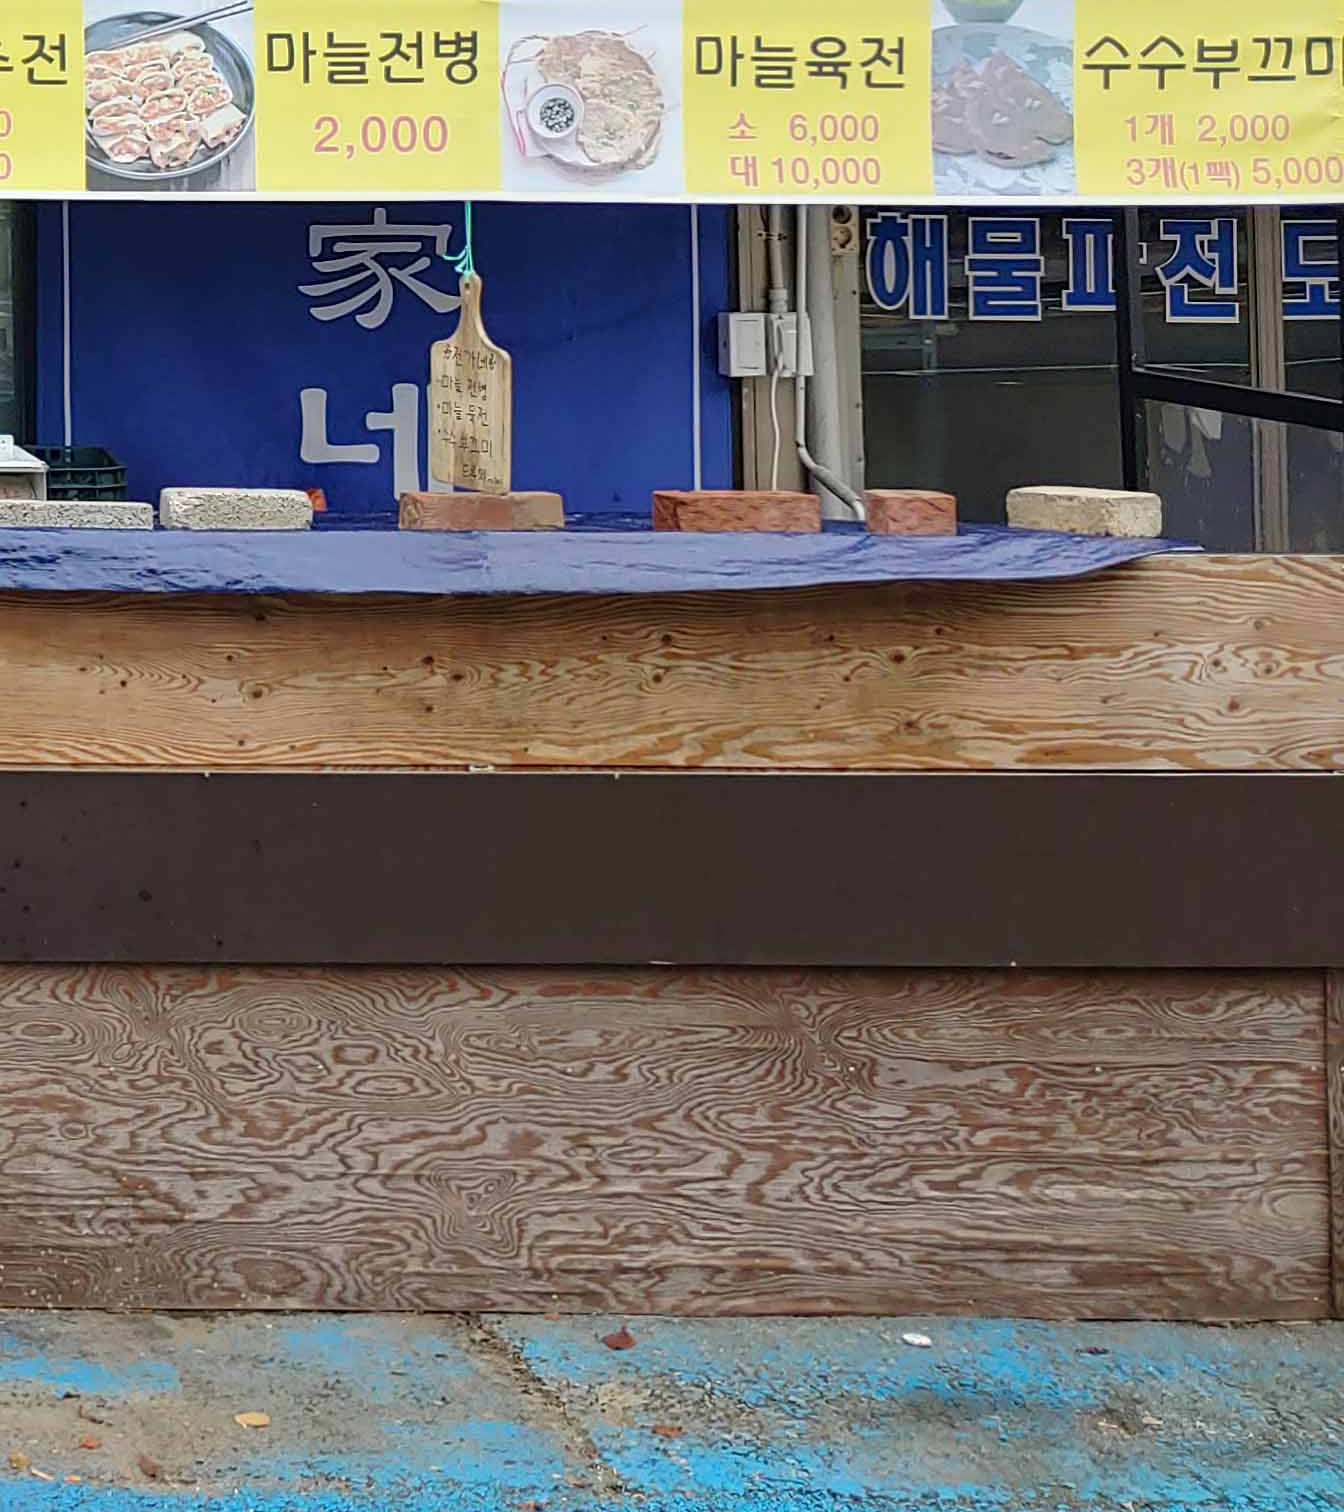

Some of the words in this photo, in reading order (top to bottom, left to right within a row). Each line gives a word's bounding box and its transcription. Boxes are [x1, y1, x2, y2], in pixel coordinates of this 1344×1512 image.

[266, 30, 480, 85] 마늘전병
[695, 35, 906, 90] 마늘육전
[313, 115, 448, 160] 2,000
[728, 113, 758, 140] 소
[789, 114, 880, 146] 6,000
[1124, 113, 1175, 145] 1개
[1198, 114, 1291, 147] 2,000
[729, 155, 759, 187] 대
[771, 157, 881, 190] 10,000
[1252, 156, 1344, 190] 5,000
